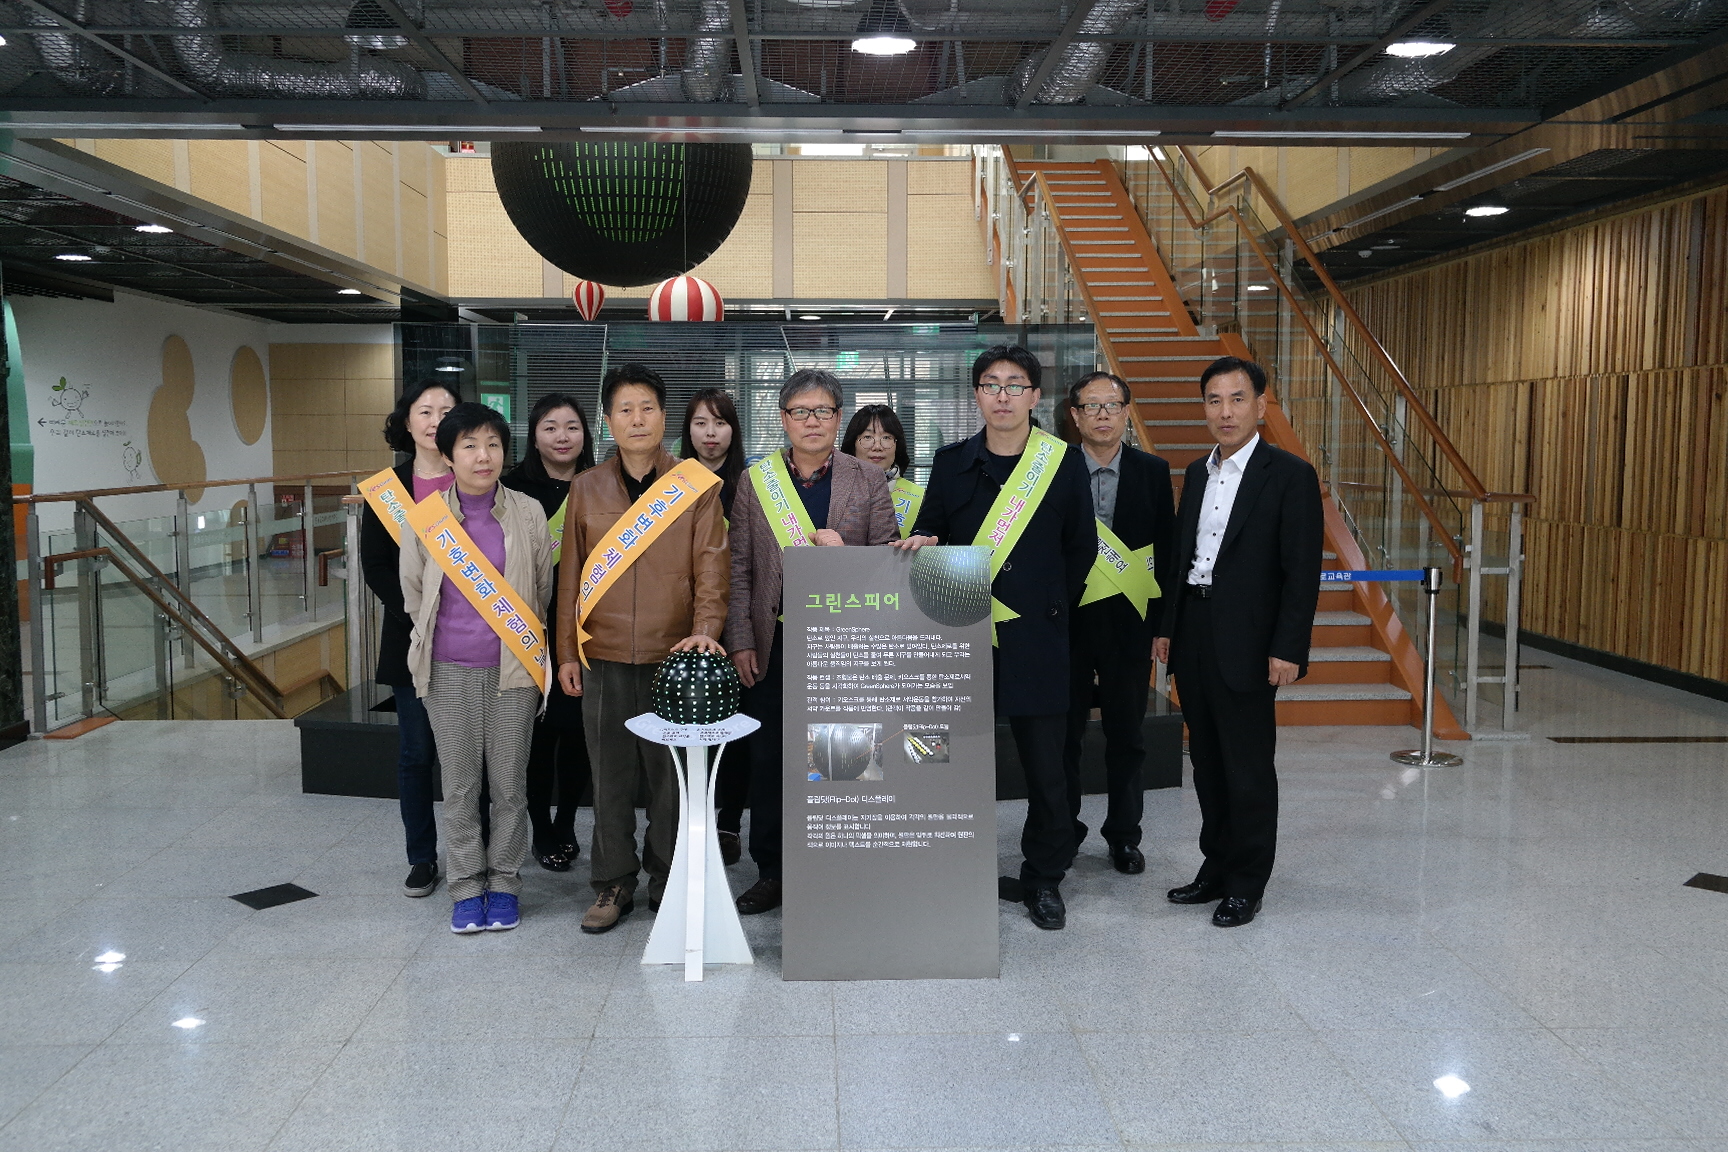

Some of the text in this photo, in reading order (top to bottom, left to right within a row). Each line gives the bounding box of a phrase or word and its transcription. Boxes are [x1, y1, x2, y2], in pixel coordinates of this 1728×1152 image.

[759, 459, 790, 513] 탄소줄이기
[1018, 441, 1054, 498] 탄소줄이기
[380, 489, 408, 529] 탄소줄
[988, 496, 1026, 547] 내가먼저
[581, 484, 685, 602] 기후변화 체험의
[436, 528, 498, 600] 기후변화
[492, 596, 539, 650] 체험의
[806, 592, 900, 613] 그린스피어
[862, 794, 896, 804] 디스플레이
